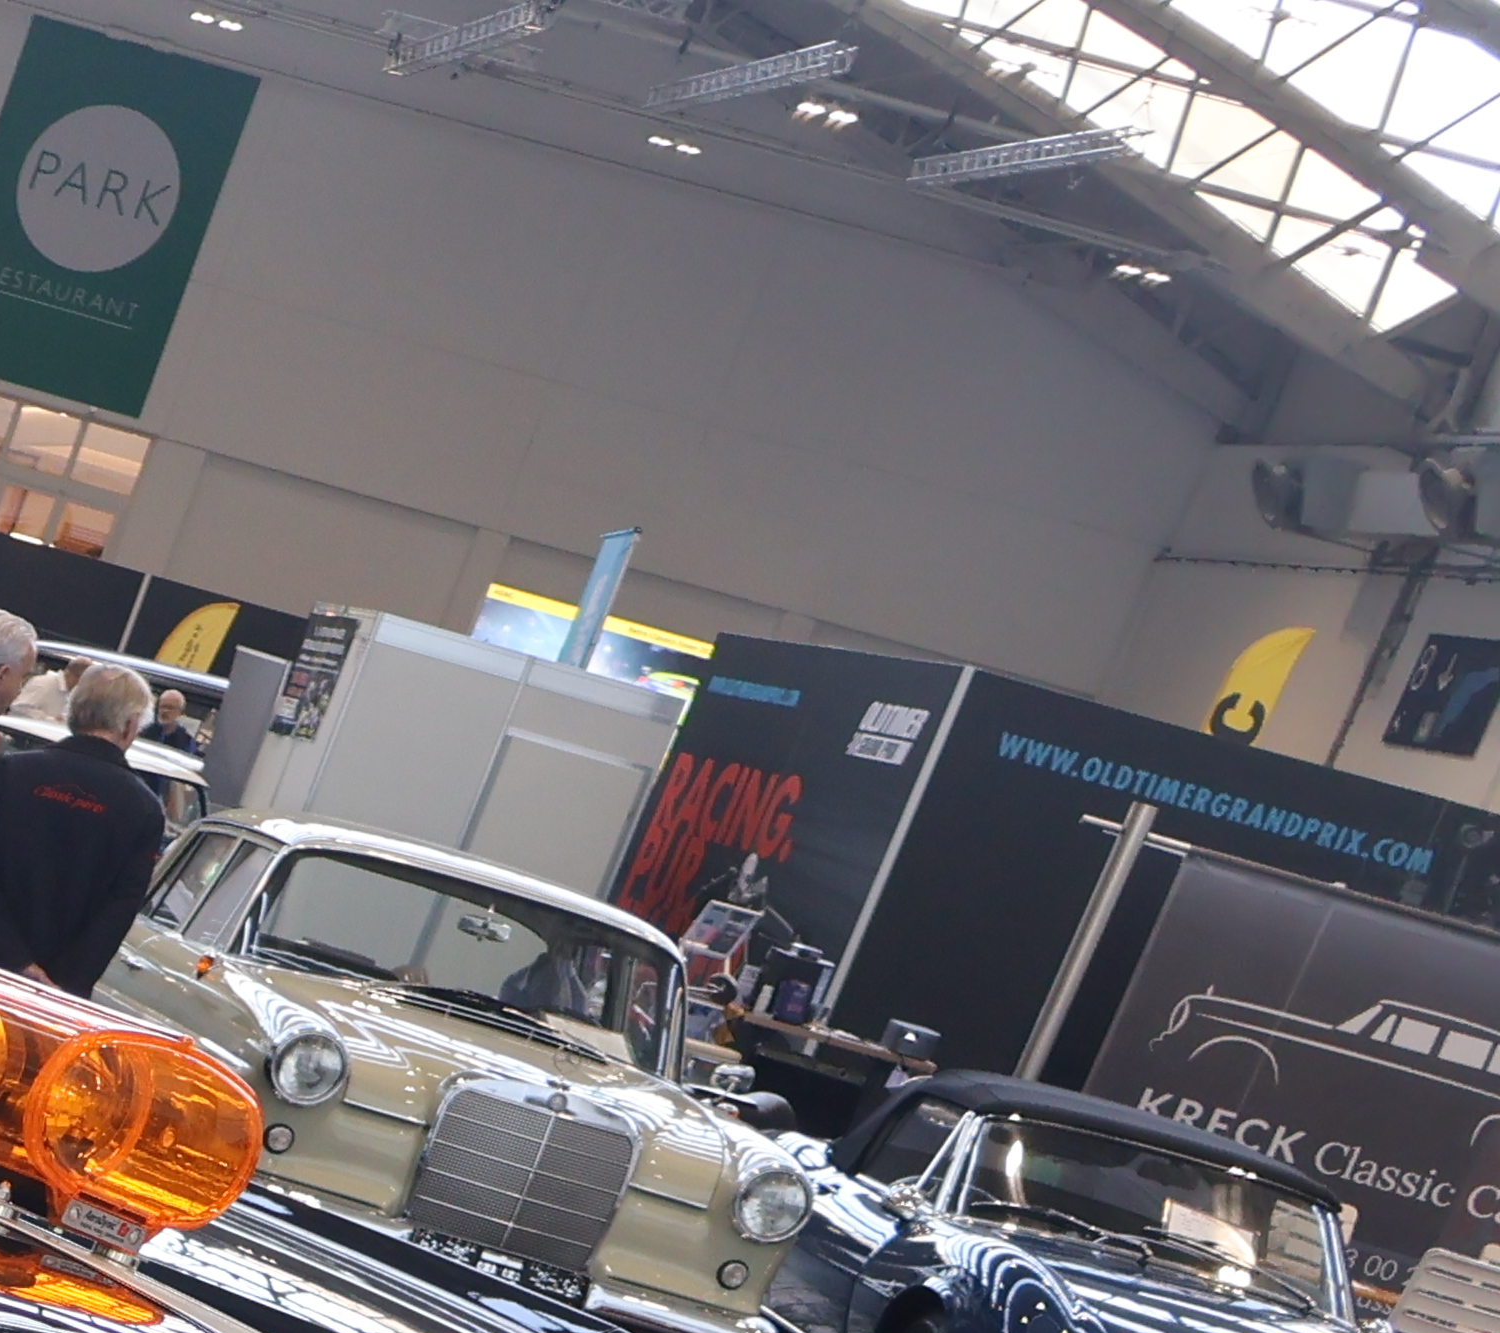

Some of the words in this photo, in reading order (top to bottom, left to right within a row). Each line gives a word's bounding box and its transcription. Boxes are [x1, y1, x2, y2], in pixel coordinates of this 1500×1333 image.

[29, 150, 171, 227] PARK
[647, 752, 803, 863] RACING.
[999, 731, 1436, 875] WWW.OLDTIMERGRANDPRIX.COM
[1136, 1087, 1306, 1165] KRECK
[1315, 1141, 1456, 1208] Classic
